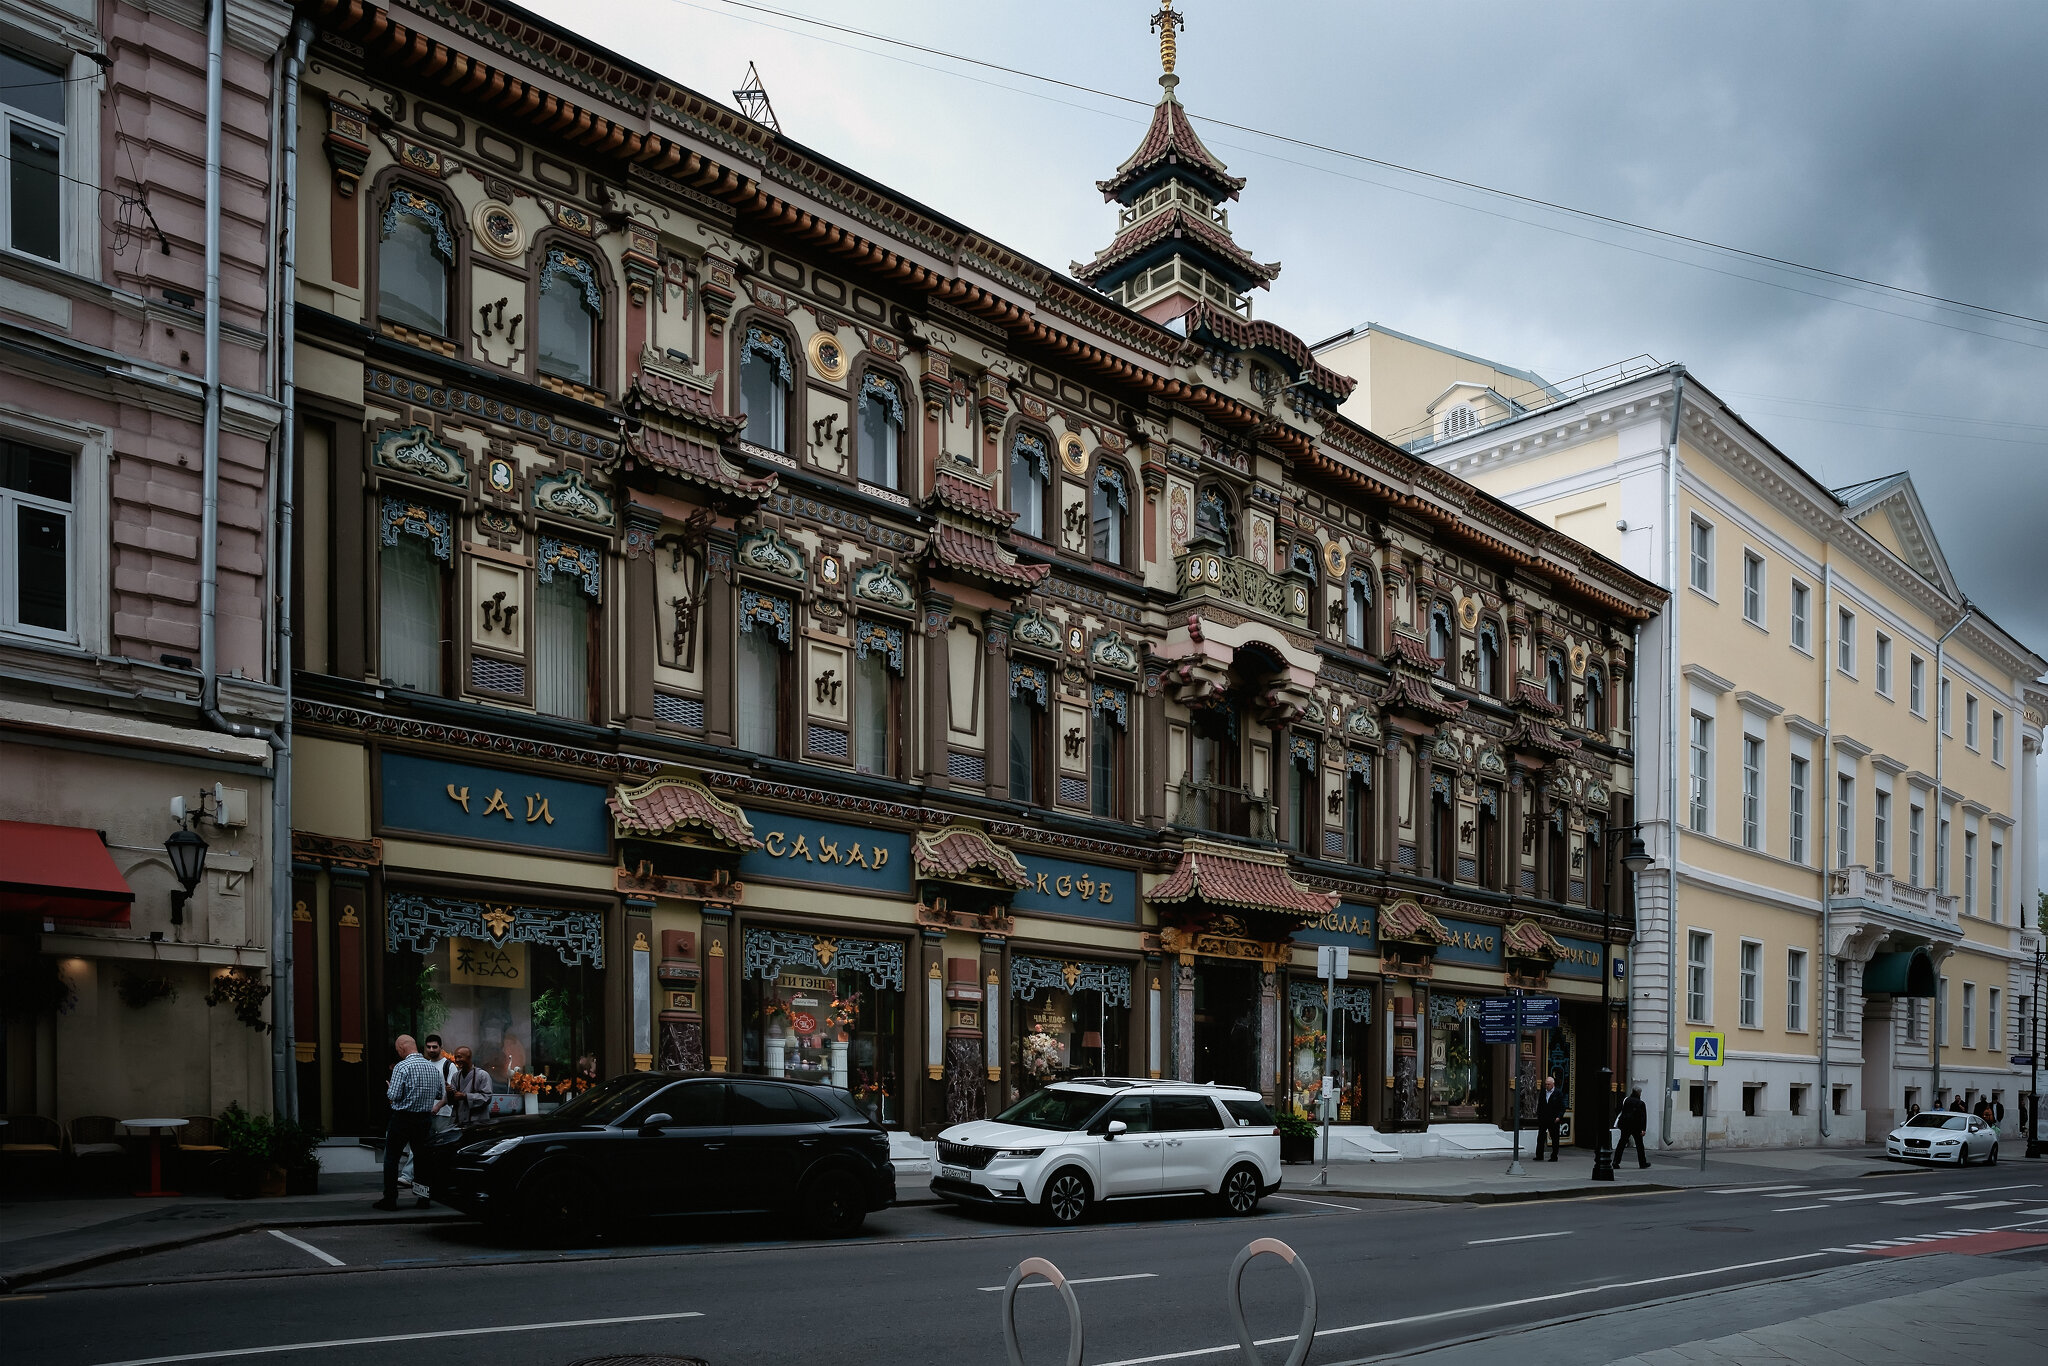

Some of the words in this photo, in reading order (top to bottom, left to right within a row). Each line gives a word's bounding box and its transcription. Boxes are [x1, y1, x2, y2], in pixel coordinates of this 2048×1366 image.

[447, 783, 555, 825] ЧАЙ
[764, 831, 889, 870] САХАР
[1036, 872, 1114, 904] КОФЕ
[1448, 930, 1494, 952] АКАО
[457, 948, 475, 975] 茶
[484, 951, 511, 963] ЧА
[1617, 963, 1624, 972] 19
[476, 961, 519, 979] БАО
